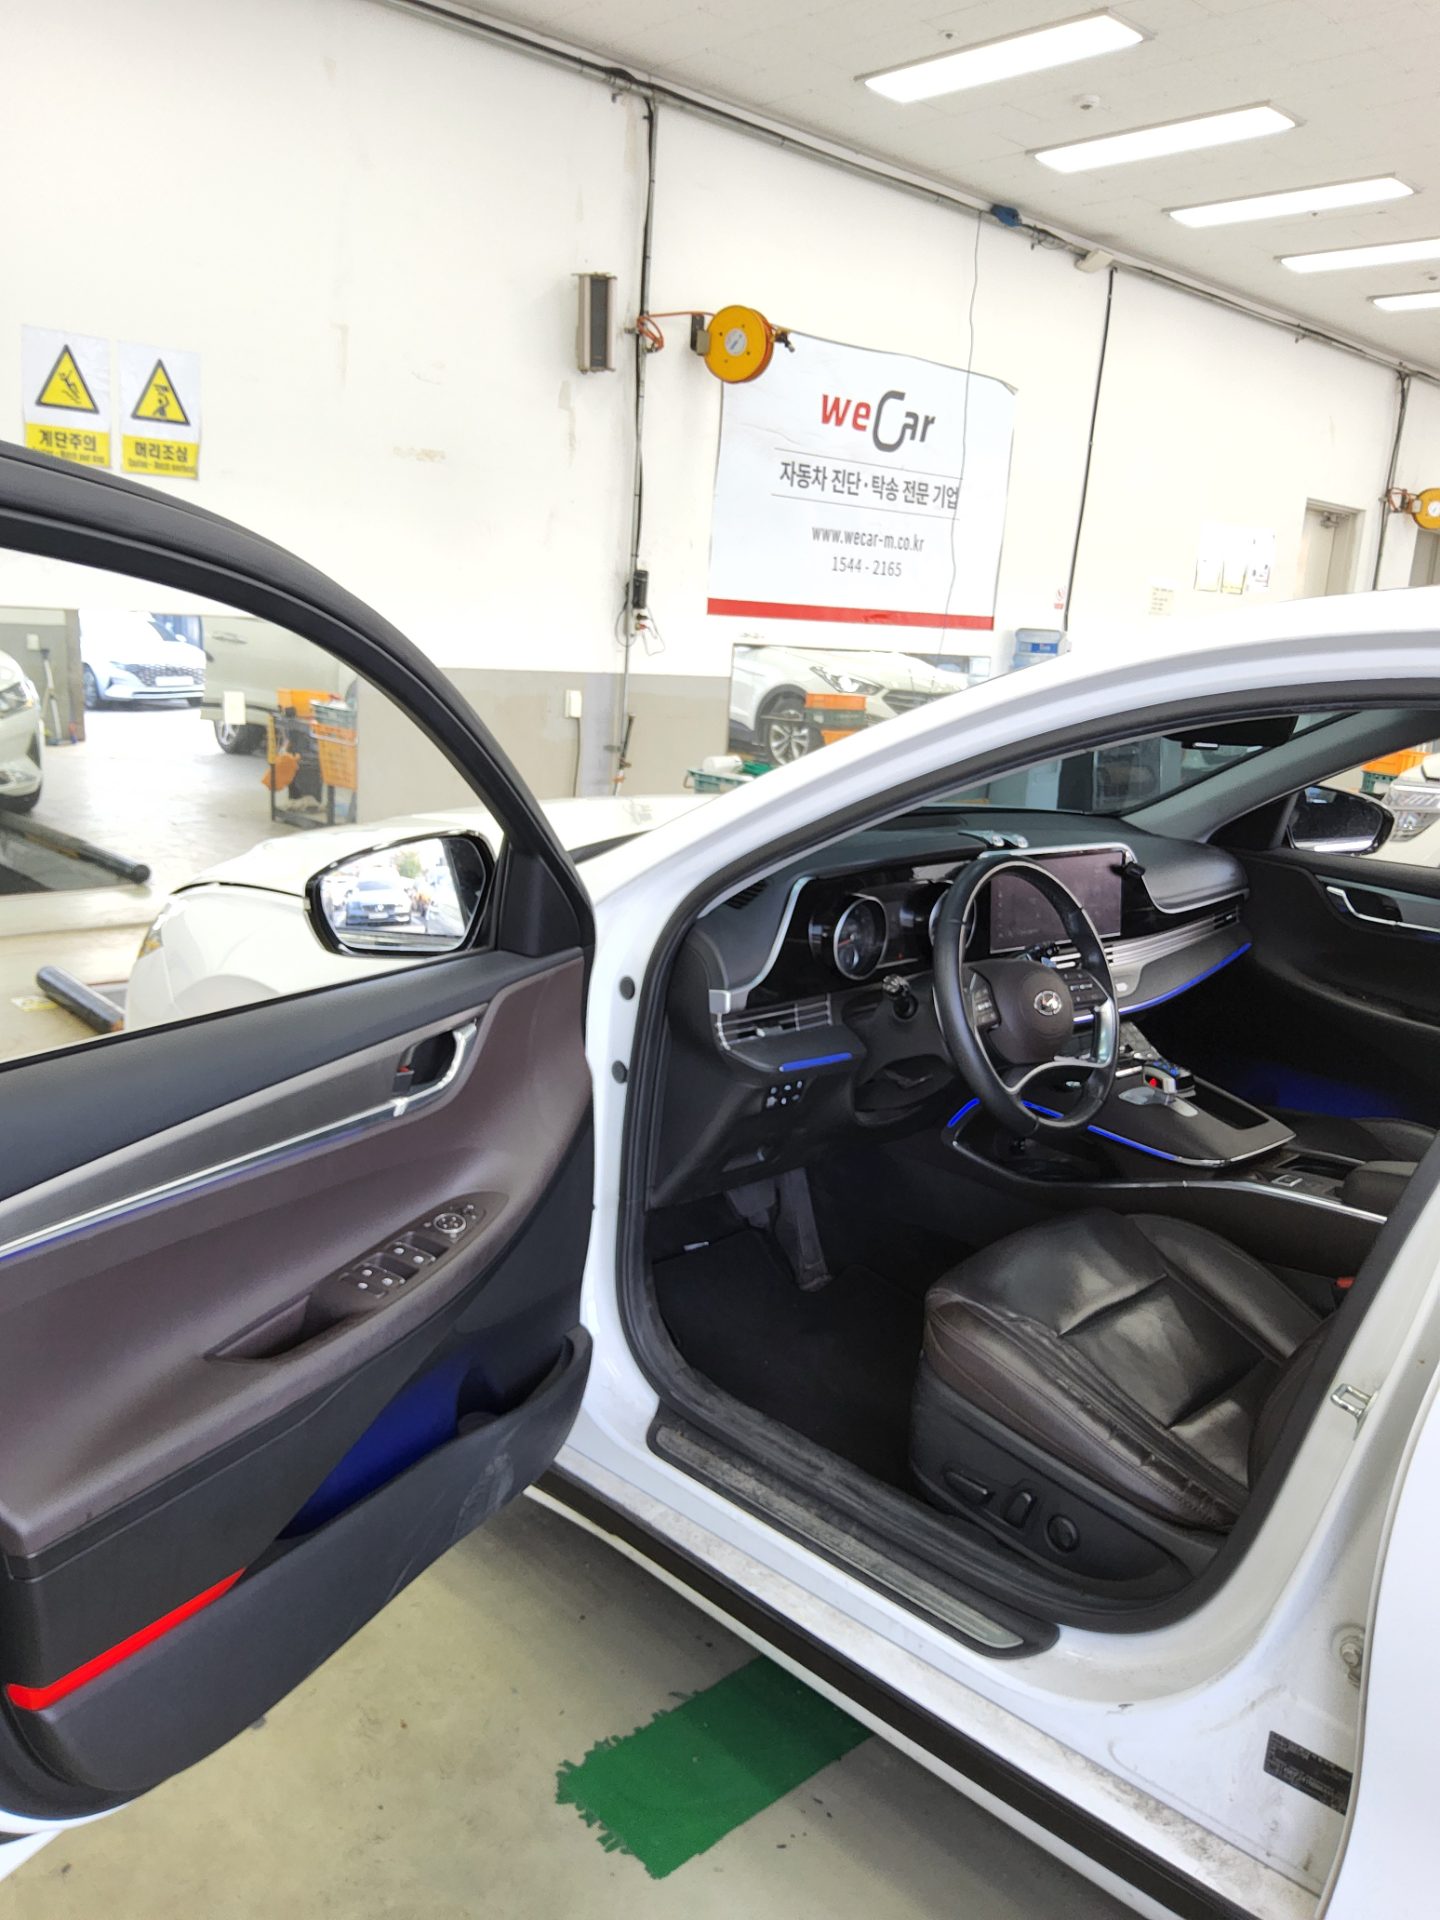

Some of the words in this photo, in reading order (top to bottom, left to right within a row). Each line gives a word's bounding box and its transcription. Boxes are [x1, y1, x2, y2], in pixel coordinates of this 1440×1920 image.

[39, 429, 97, 451] 계단주의
[135, 441, 188, 462] 머리조심
[779, 460, 828, 492] 자동차
[902, 479, 930, 507] 전문
[932, 484, 960, 510] 기업
[812, 526, 925, 552] www.wecar-m.co.kr
